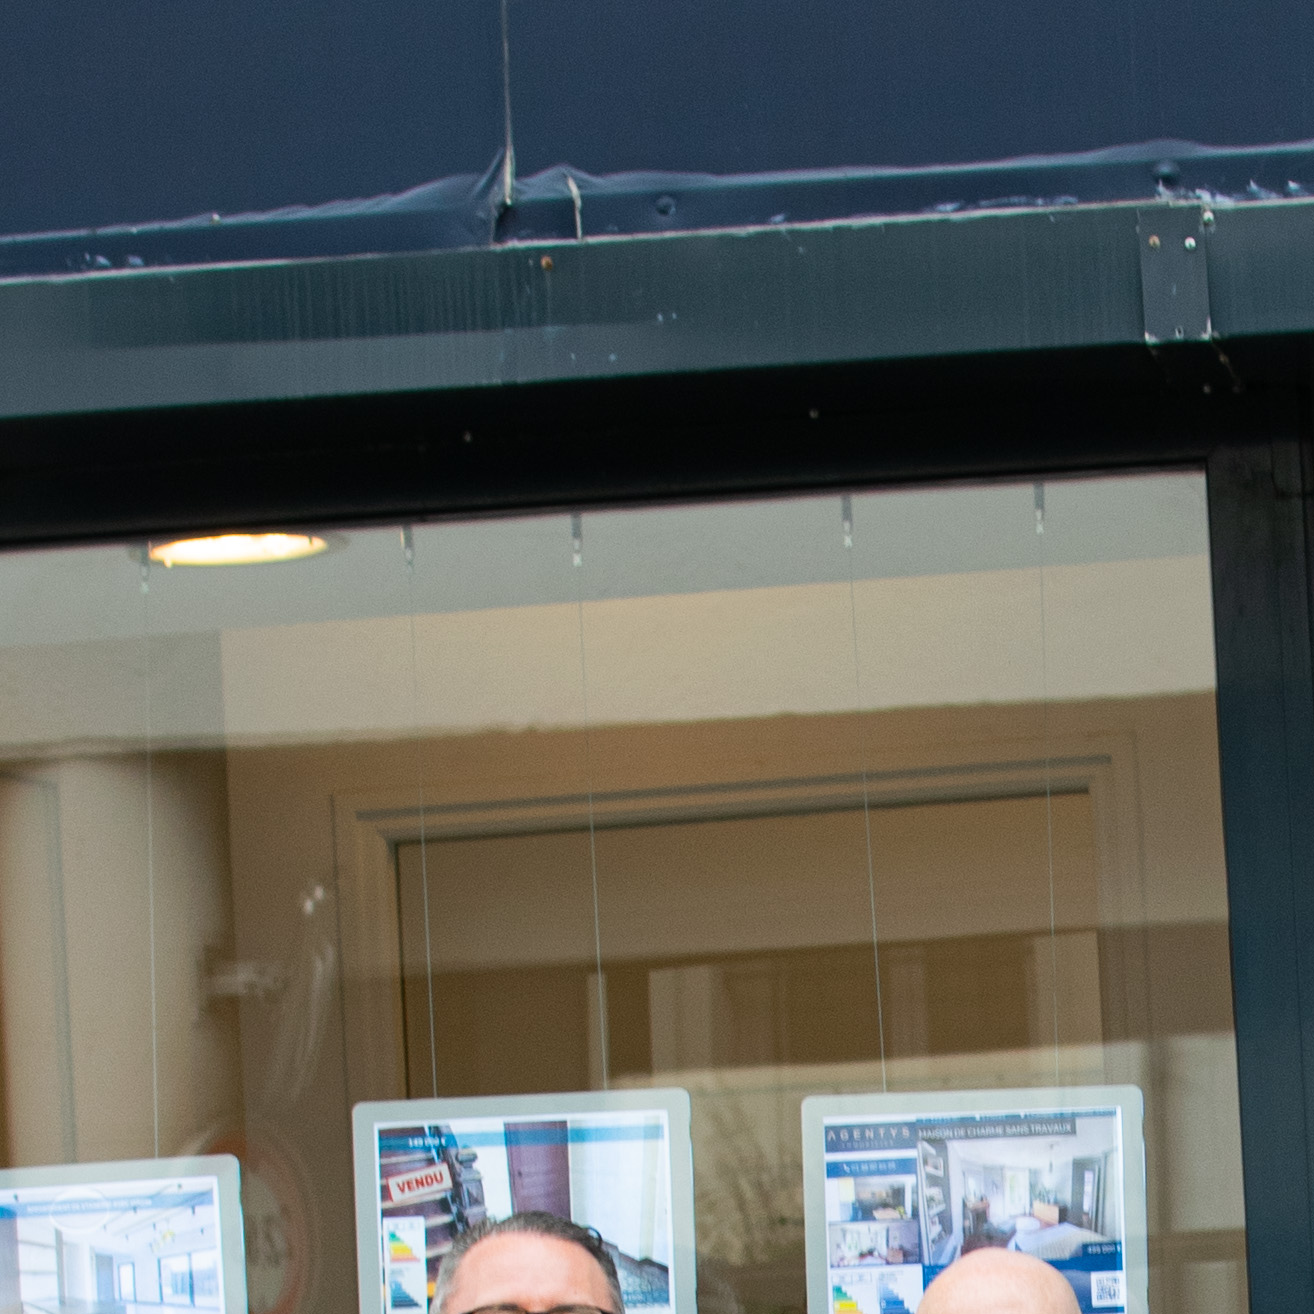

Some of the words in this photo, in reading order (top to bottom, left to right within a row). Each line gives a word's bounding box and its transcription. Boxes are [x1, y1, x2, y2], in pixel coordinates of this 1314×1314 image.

[826, 1125, 911, 1142] AGENTYS
[918, 1127, 953, 1140] MAISON
[953, 1126, 966, 1138] DE
[967, 1125, 1004, 1137] CHARME
[1005, 1123, 1029, 1136] SANS
[1030, 1121, 1072, 1134] TRAVAUX
[396, 1171, 445, 1194] VENDU
